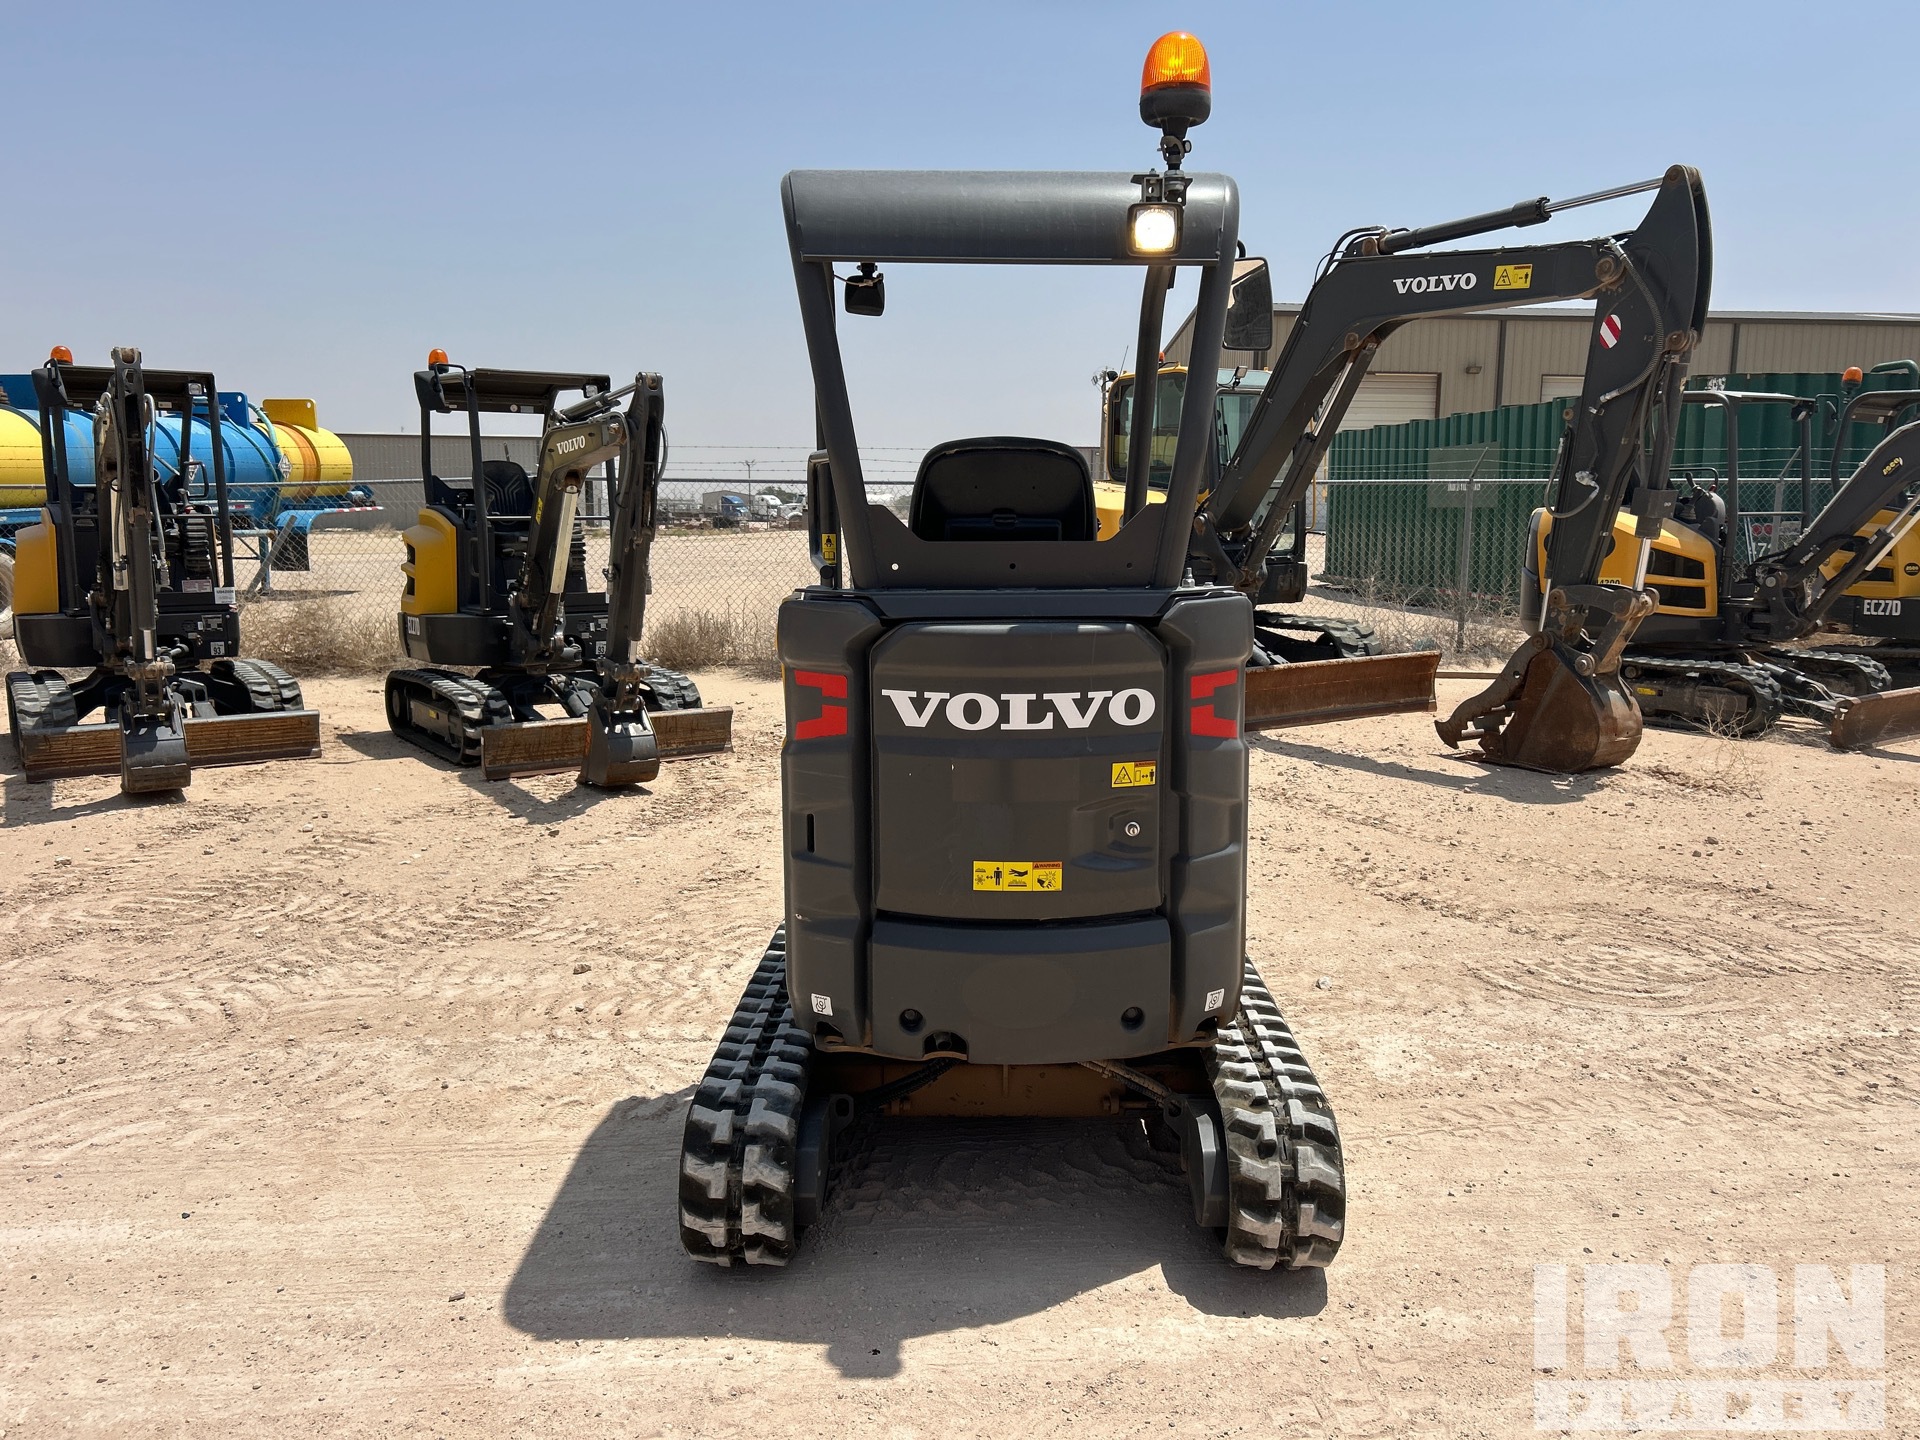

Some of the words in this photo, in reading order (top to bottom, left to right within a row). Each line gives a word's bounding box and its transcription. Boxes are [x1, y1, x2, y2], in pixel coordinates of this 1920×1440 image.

[1393, 272, 1477, 294] VOLVO
[556, 435, 586, 455] VOLVO
[1863, 599, 1902, 616] EC27D
[881, 688, 1156, 731] VOLVO
